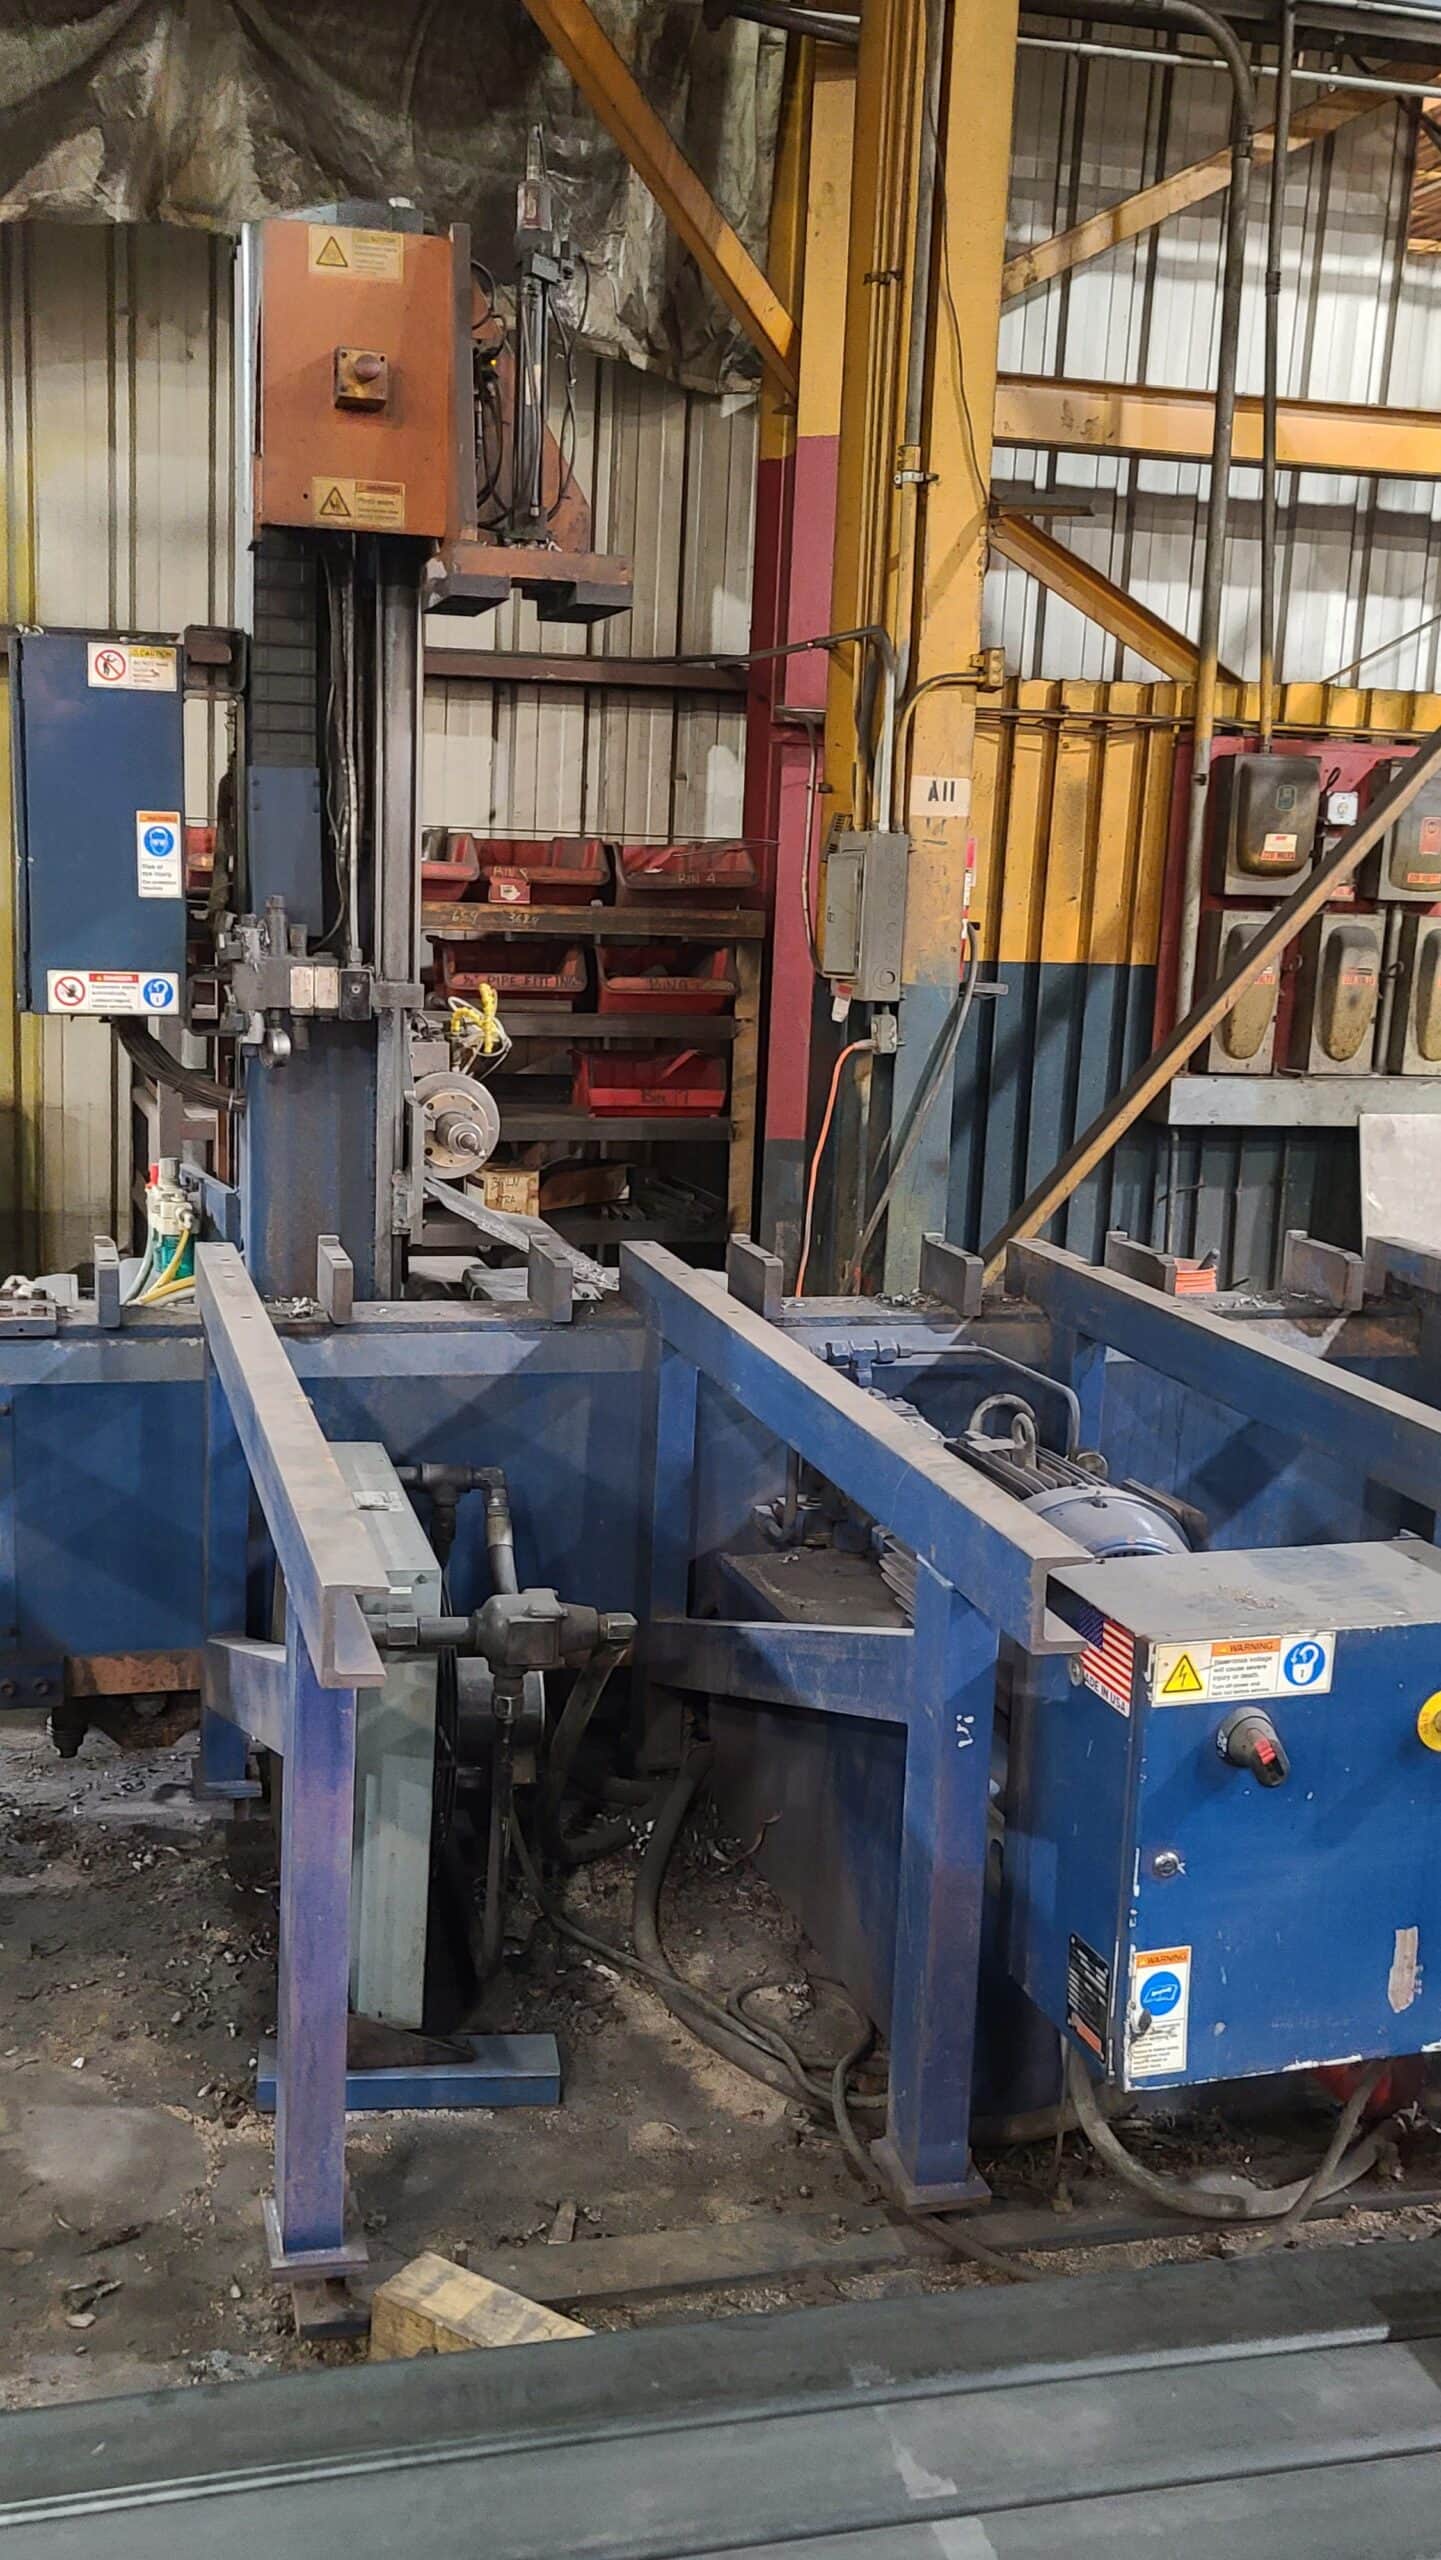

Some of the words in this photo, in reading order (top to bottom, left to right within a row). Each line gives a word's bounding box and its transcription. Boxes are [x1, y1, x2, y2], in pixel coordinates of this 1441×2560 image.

[1230, 1641, 1273, 1652] WARNING
[1101, 1685, 1109, 1700] IN
[1110, 1691, 1126, 1713] USA
[1147, 1952, 1186, 1964] WARNING
